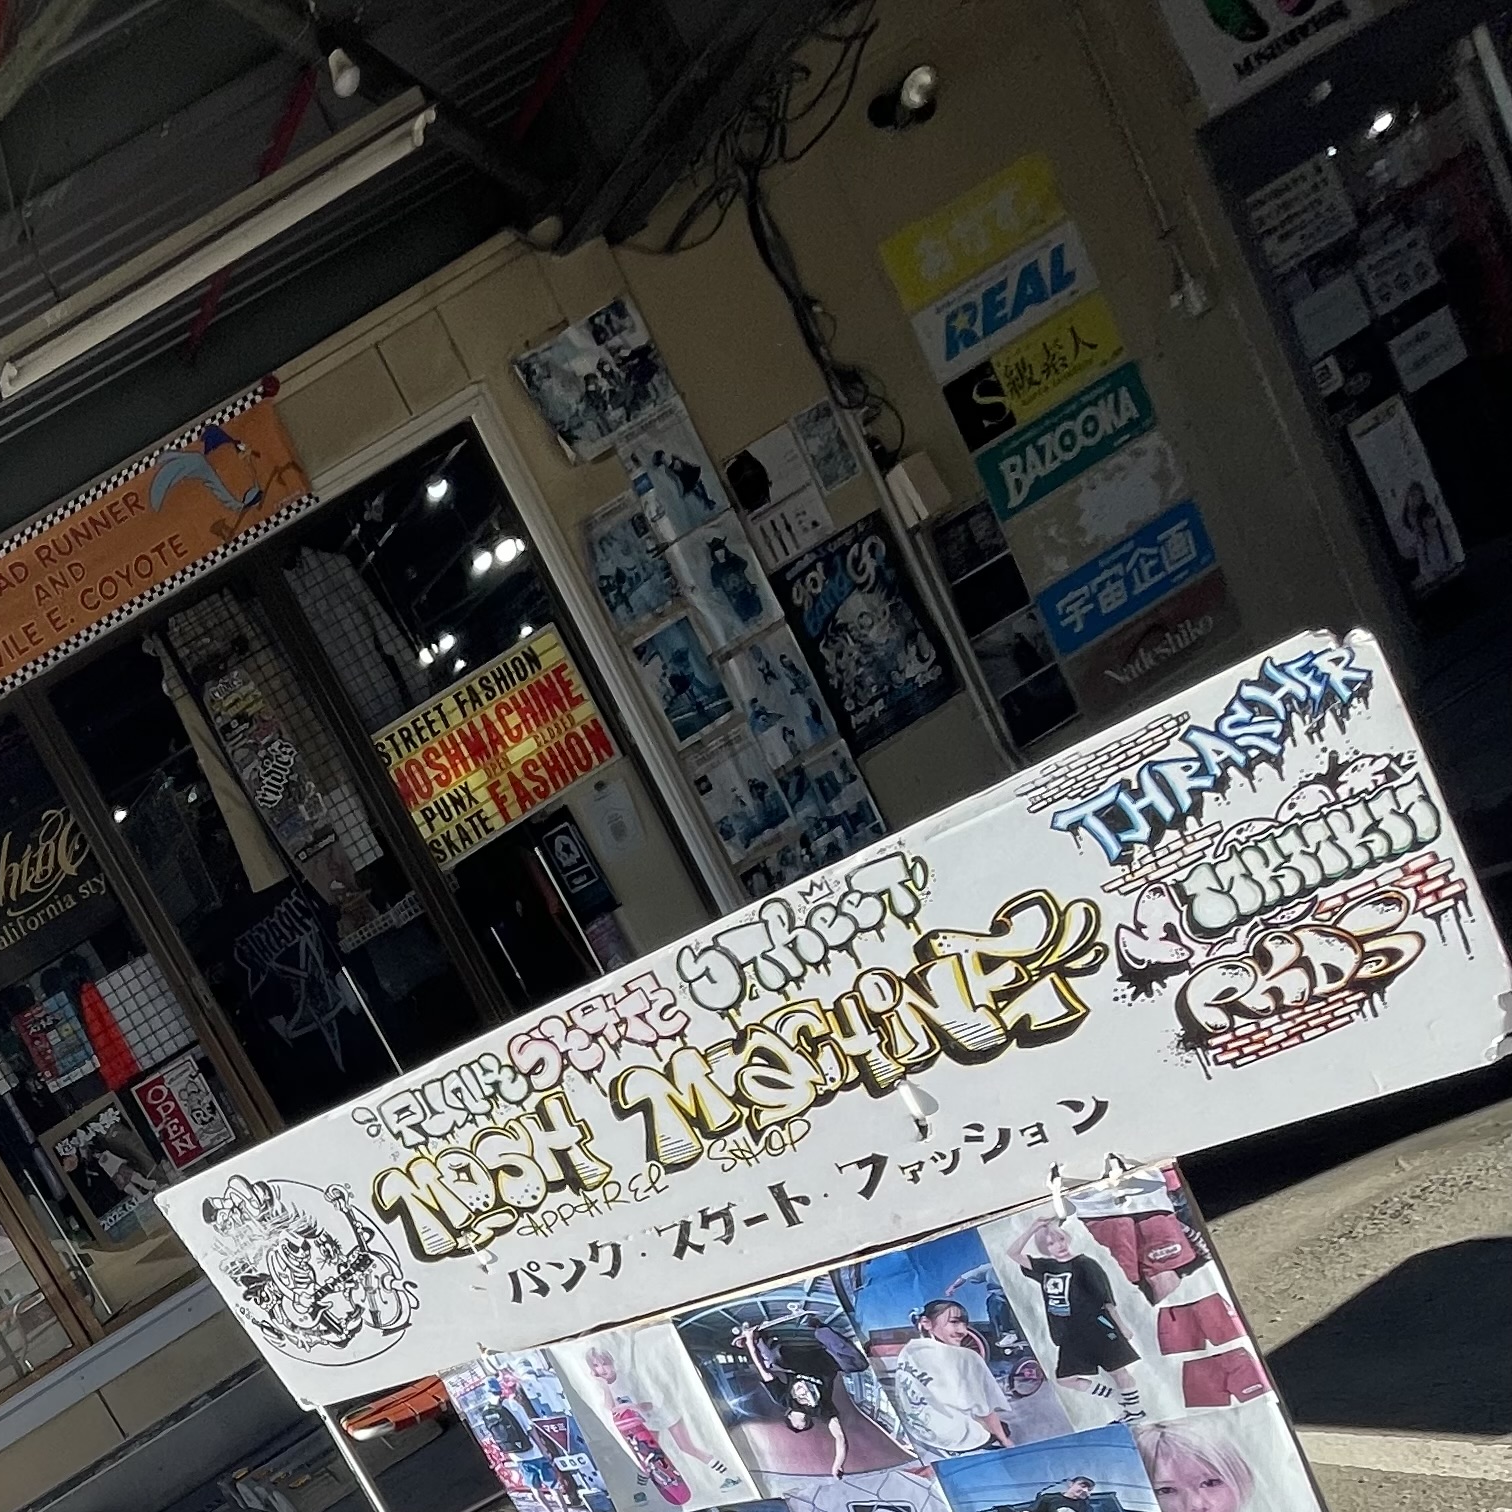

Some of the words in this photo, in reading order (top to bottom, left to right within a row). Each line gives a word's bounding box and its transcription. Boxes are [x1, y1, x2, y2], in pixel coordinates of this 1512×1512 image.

[939, 243, 1077, 363] REAL
[997, 385, 1139, 510] BAZOOKA
[33, 561, 87, 607] AND
[35, 491, 145, 580] RUNNER
[49, 604, 77, 635] E.
[80, 533, 188, 613] COYOTE
[1055, 520, 1197, 632] 宇宙企画
[374, 702, 451, 768] STREET
[452, 646, 543, 720] FASHION
[1050, 646, 1374, 862] THRASHER
[420, 780, 479, 833] PUNX
[486, 718, 616, 824] FASHION
[428, 808, 495, 863] SKATE
[145, 1081, 196, 1158] OPEN
[372, 1091, 613, 1262] MOSH
[517, 1161, 668, 1238] APPAREL
[707, 1118, 814, 1174] SHOP
